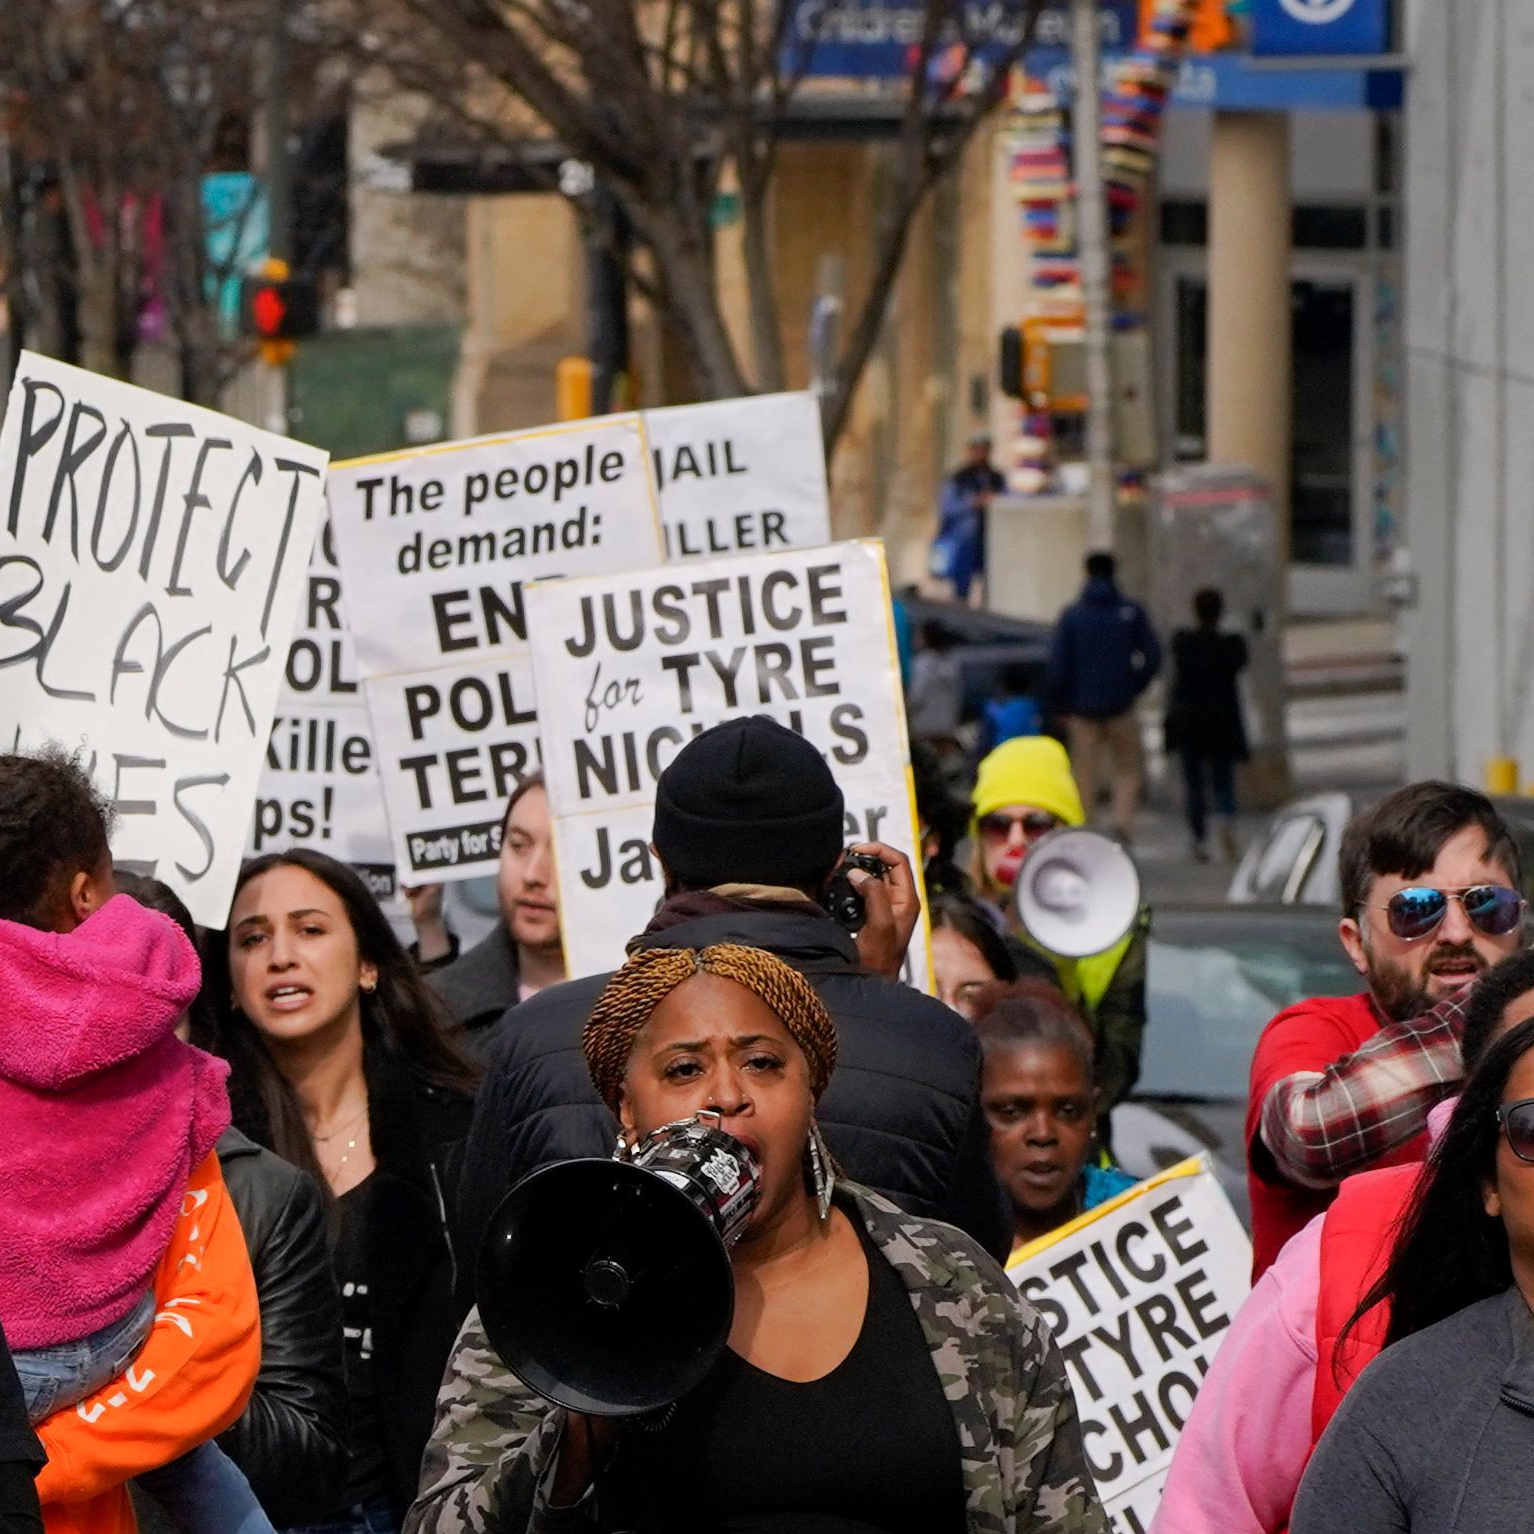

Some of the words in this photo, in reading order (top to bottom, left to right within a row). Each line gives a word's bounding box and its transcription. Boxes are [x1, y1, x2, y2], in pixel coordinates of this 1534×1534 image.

[7, 376, 321, 643] PROTECT
[355, 475, 445, 521] The
[464, 443, 625, 515] people
[397, 507, 603, 577] demand:
[564, 563, 848, 660] JUSTICE
[584, 661, 645, 734] for
[661, 636, 841, 715] TYRE
[411, 829, 460, 865] Party
[462, 825, 490, 857] for
[1063, 1268, 1231, 1402] TYRE
